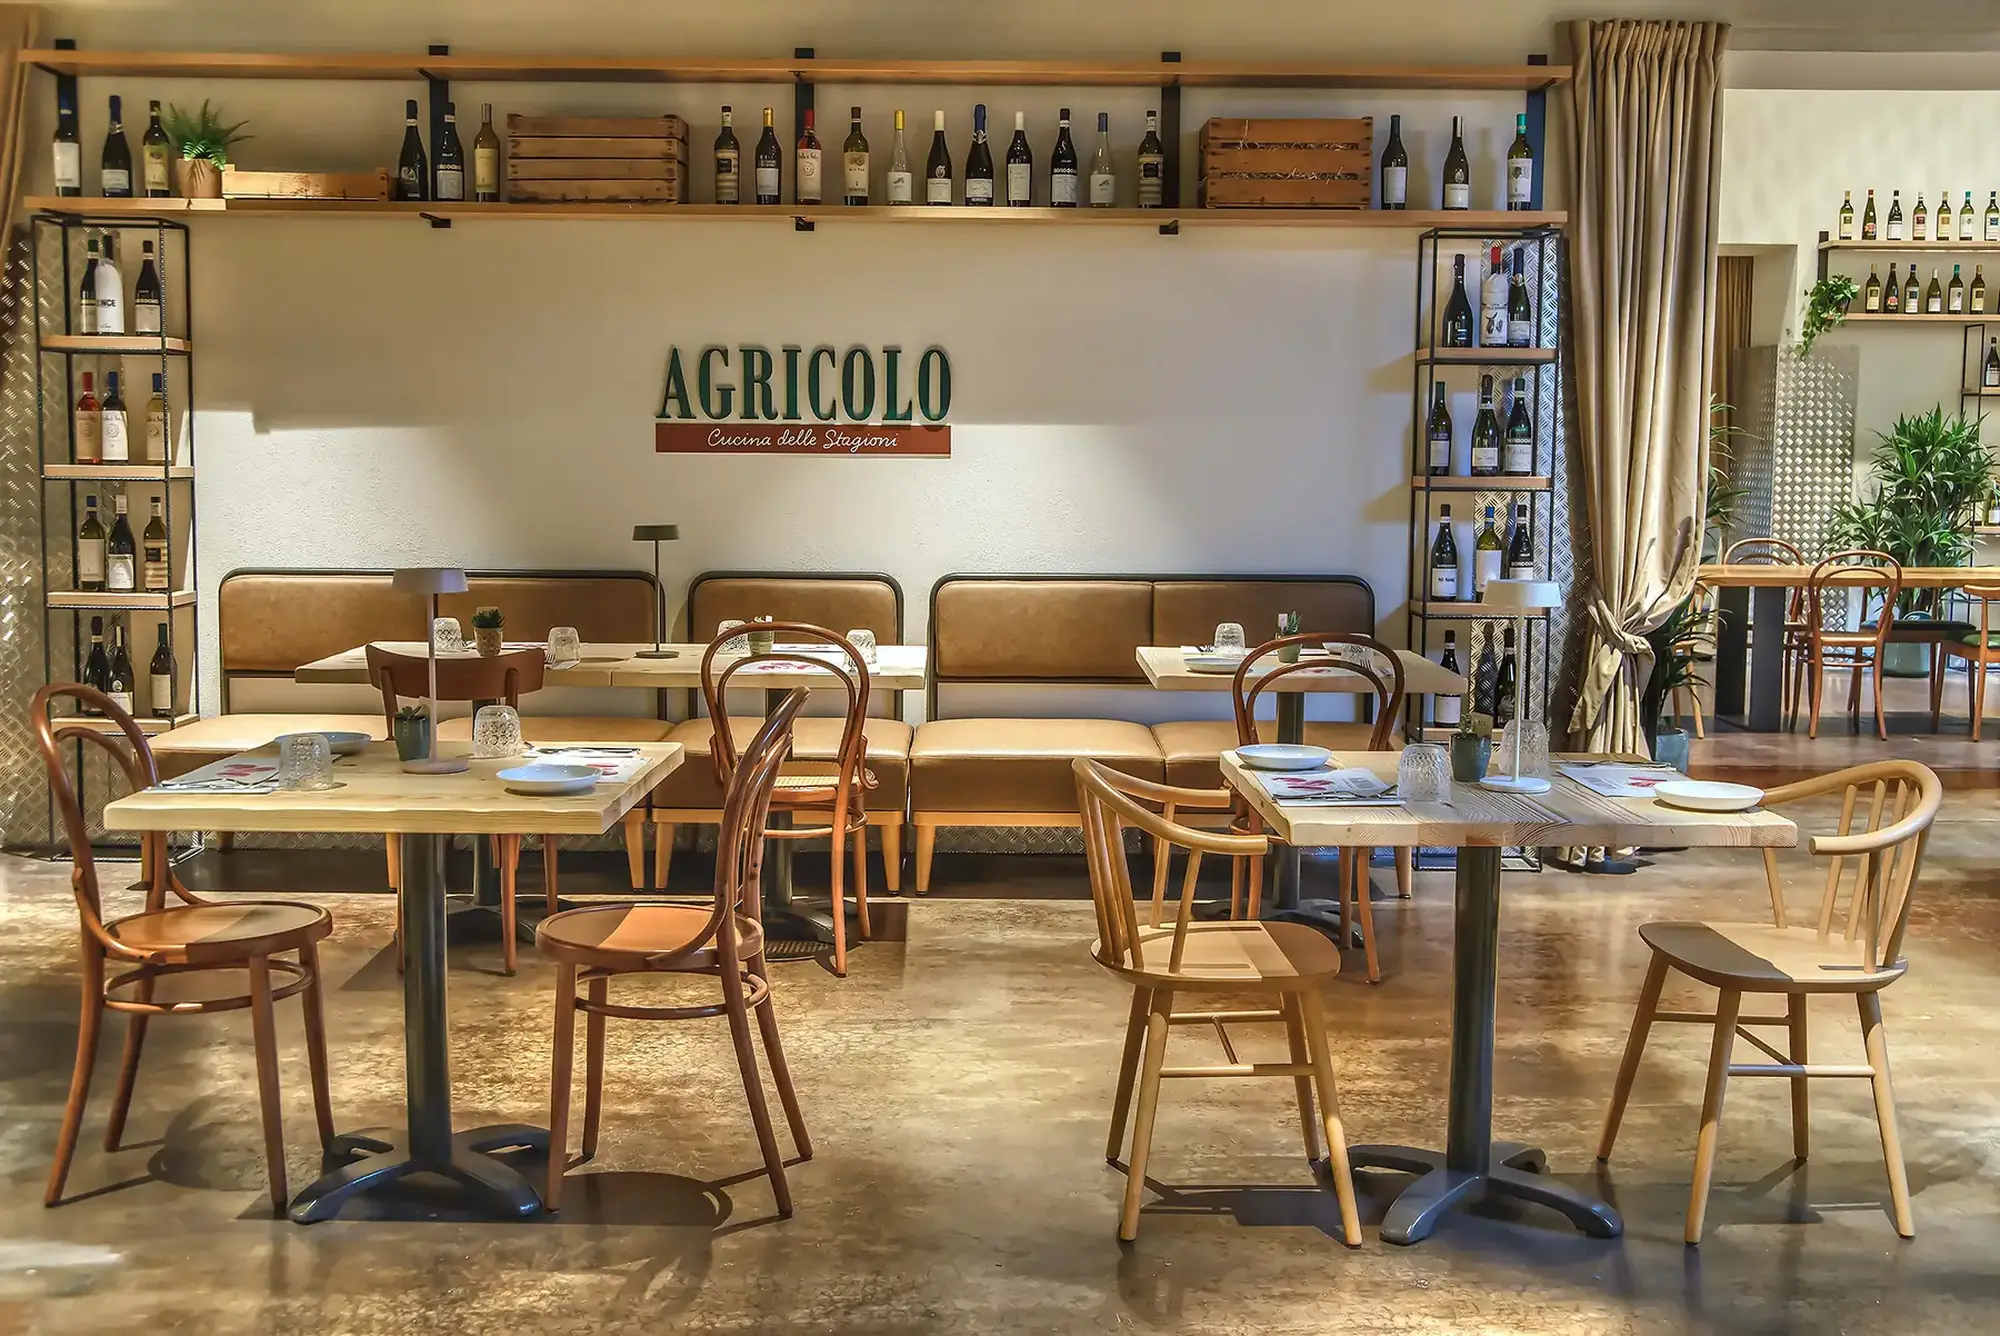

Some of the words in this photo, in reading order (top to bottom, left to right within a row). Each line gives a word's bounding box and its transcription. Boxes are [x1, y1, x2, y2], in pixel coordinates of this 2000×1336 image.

[655, 346, 952, 421] AGRICOLO
[707, 428, 772, 448] Cucina
[777, 428, 817, 448] delle
[822, 429, 899, 453] Stagioni
